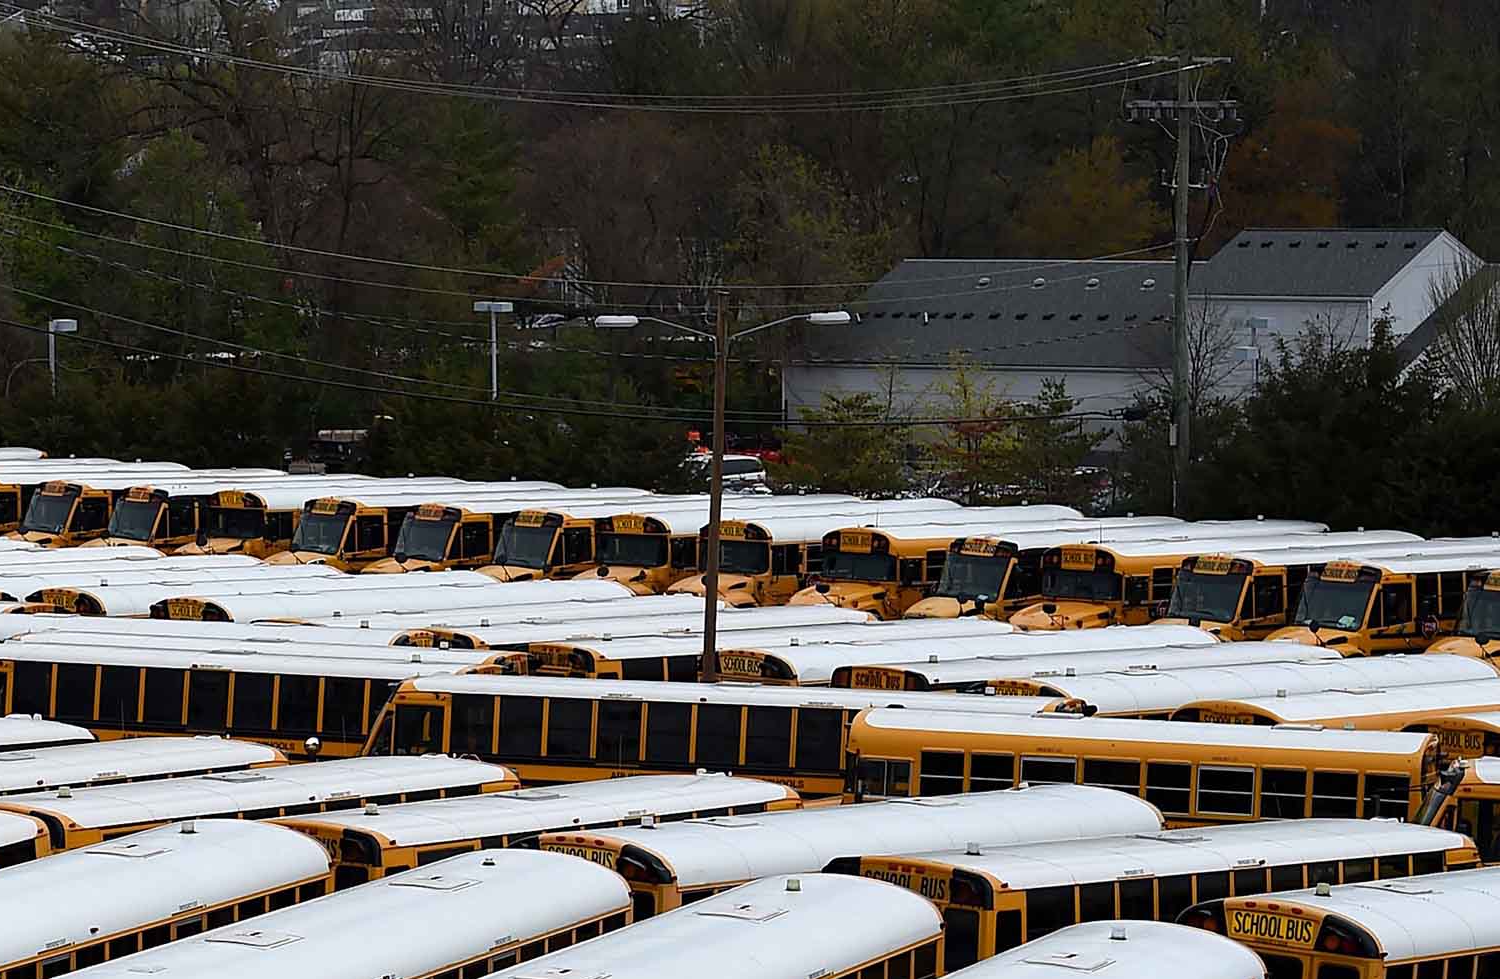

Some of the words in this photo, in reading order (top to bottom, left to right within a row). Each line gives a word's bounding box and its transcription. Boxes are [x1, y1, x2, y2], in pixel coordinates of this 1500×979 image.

[723, 656, 746, 671] SCHOOL
[747, 659, 761, 673] BUS
[1465, 735, 1481, 750] BUS
[1233, 912, 1284, 940] SCHOOL
[1286, 915, 1312, 943] BUS
